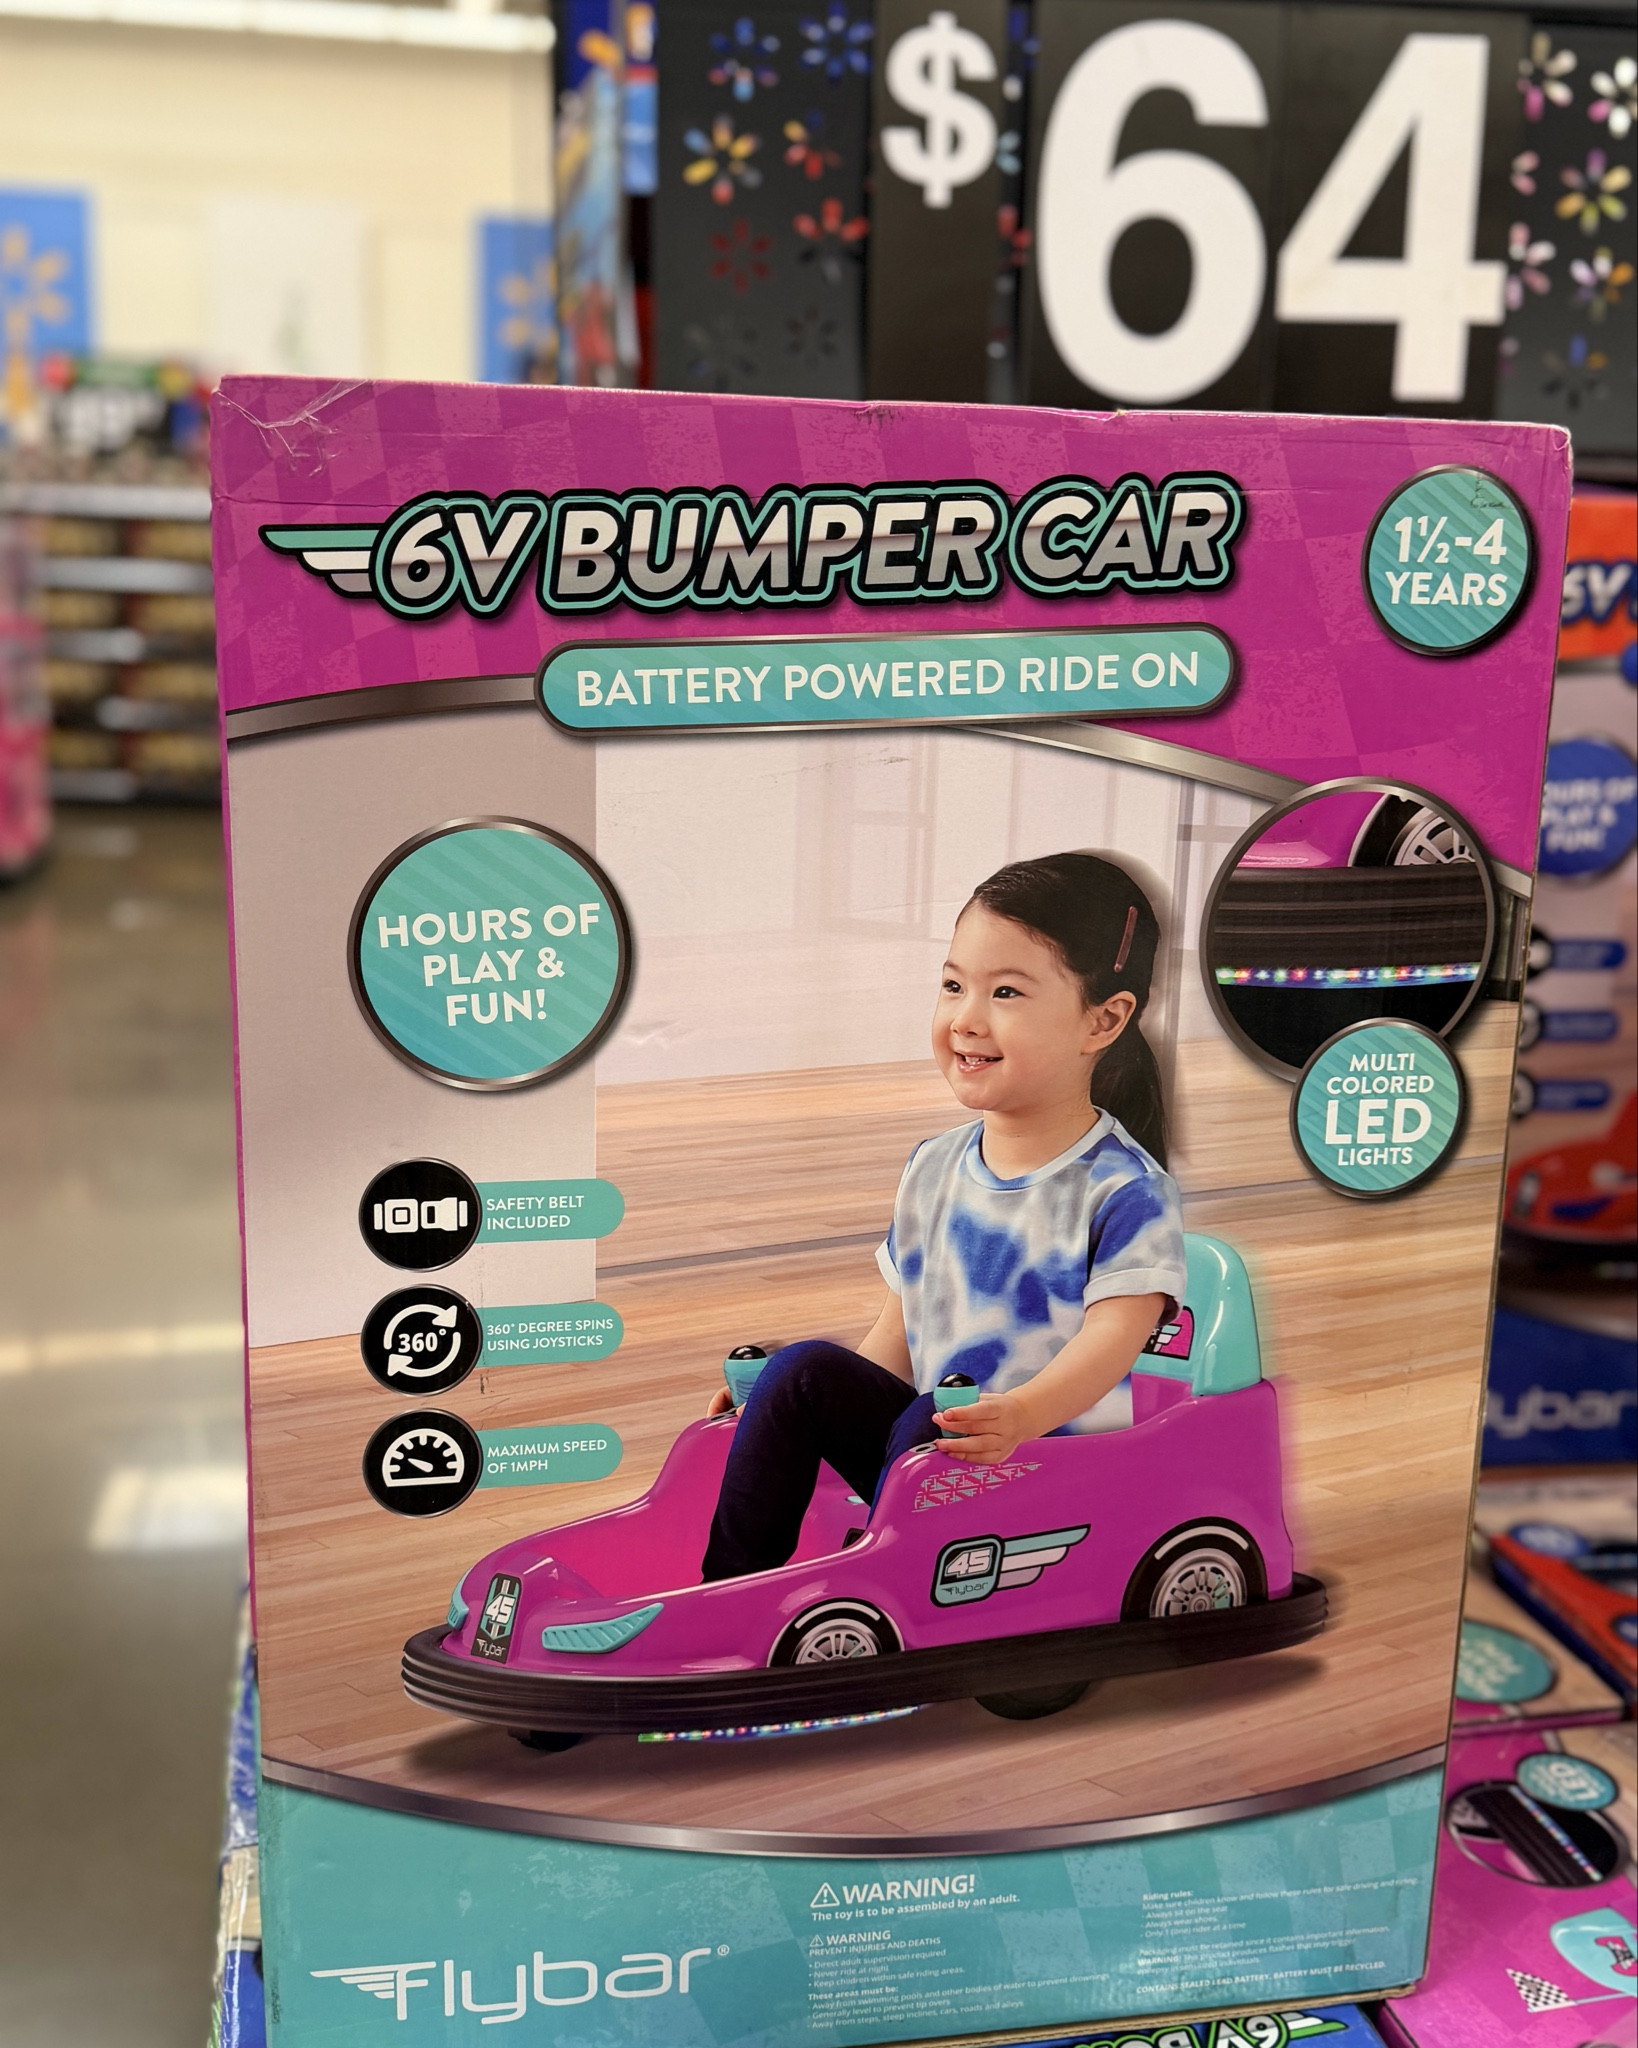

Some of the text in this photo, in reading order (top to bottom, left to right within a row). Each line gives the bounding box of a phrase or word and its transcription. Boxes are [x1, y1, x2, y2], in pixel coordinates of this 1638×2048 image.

[387, 490, 1230, 601] 6V BUMPER CAR
[1385, 572, 1508, 606] YEARS
[577, 652, 1199, 707] BATTERY POWERED RIDE ON
[378, 902, 600, 948] HOURS OF
[423, 947, 565, 987] PLAY &
[446, 988, 547, 1027] FUN!
[1350, 1053, 1415, 1072] MULTI
[1327, 1076, 1434, 1094] COLORED
[1325, 1098, 1432, 1144] LED
[1338, 1147, 1413, 1166] LIGHTS
[486, 1196, 584, 1211] SAFETY BELT
[487, 1215, 571, 1230] INCLUDED
[518, 1320, 572, 1334] DEGREE
[576, 1318, 613, 1331] SPINS
[398, 1328, 447, 1353] 360°
[488, 1335, 603, 1351] USING JOYSTICKS
[488, 1440, 607, 1457] MAXIMUM SPEED
[488, 1460, 548, 1474] OF 1MPH
[944, 1546, 994, 1578] 45
[486, 1594, 516, 1625] 45
[842, 1874, 975, 1904] WARNING!
[812, 1894, 1020, 1922] The toy is to be assembled by an adult.
[809, 1937, 941, 1957] PREVENT INJURIES AND DEATHS
[826, 1930, 891, 1945] WARNING
[808, 1993, 833, 2001] These
[836, 1990, 859, 1998] areas
